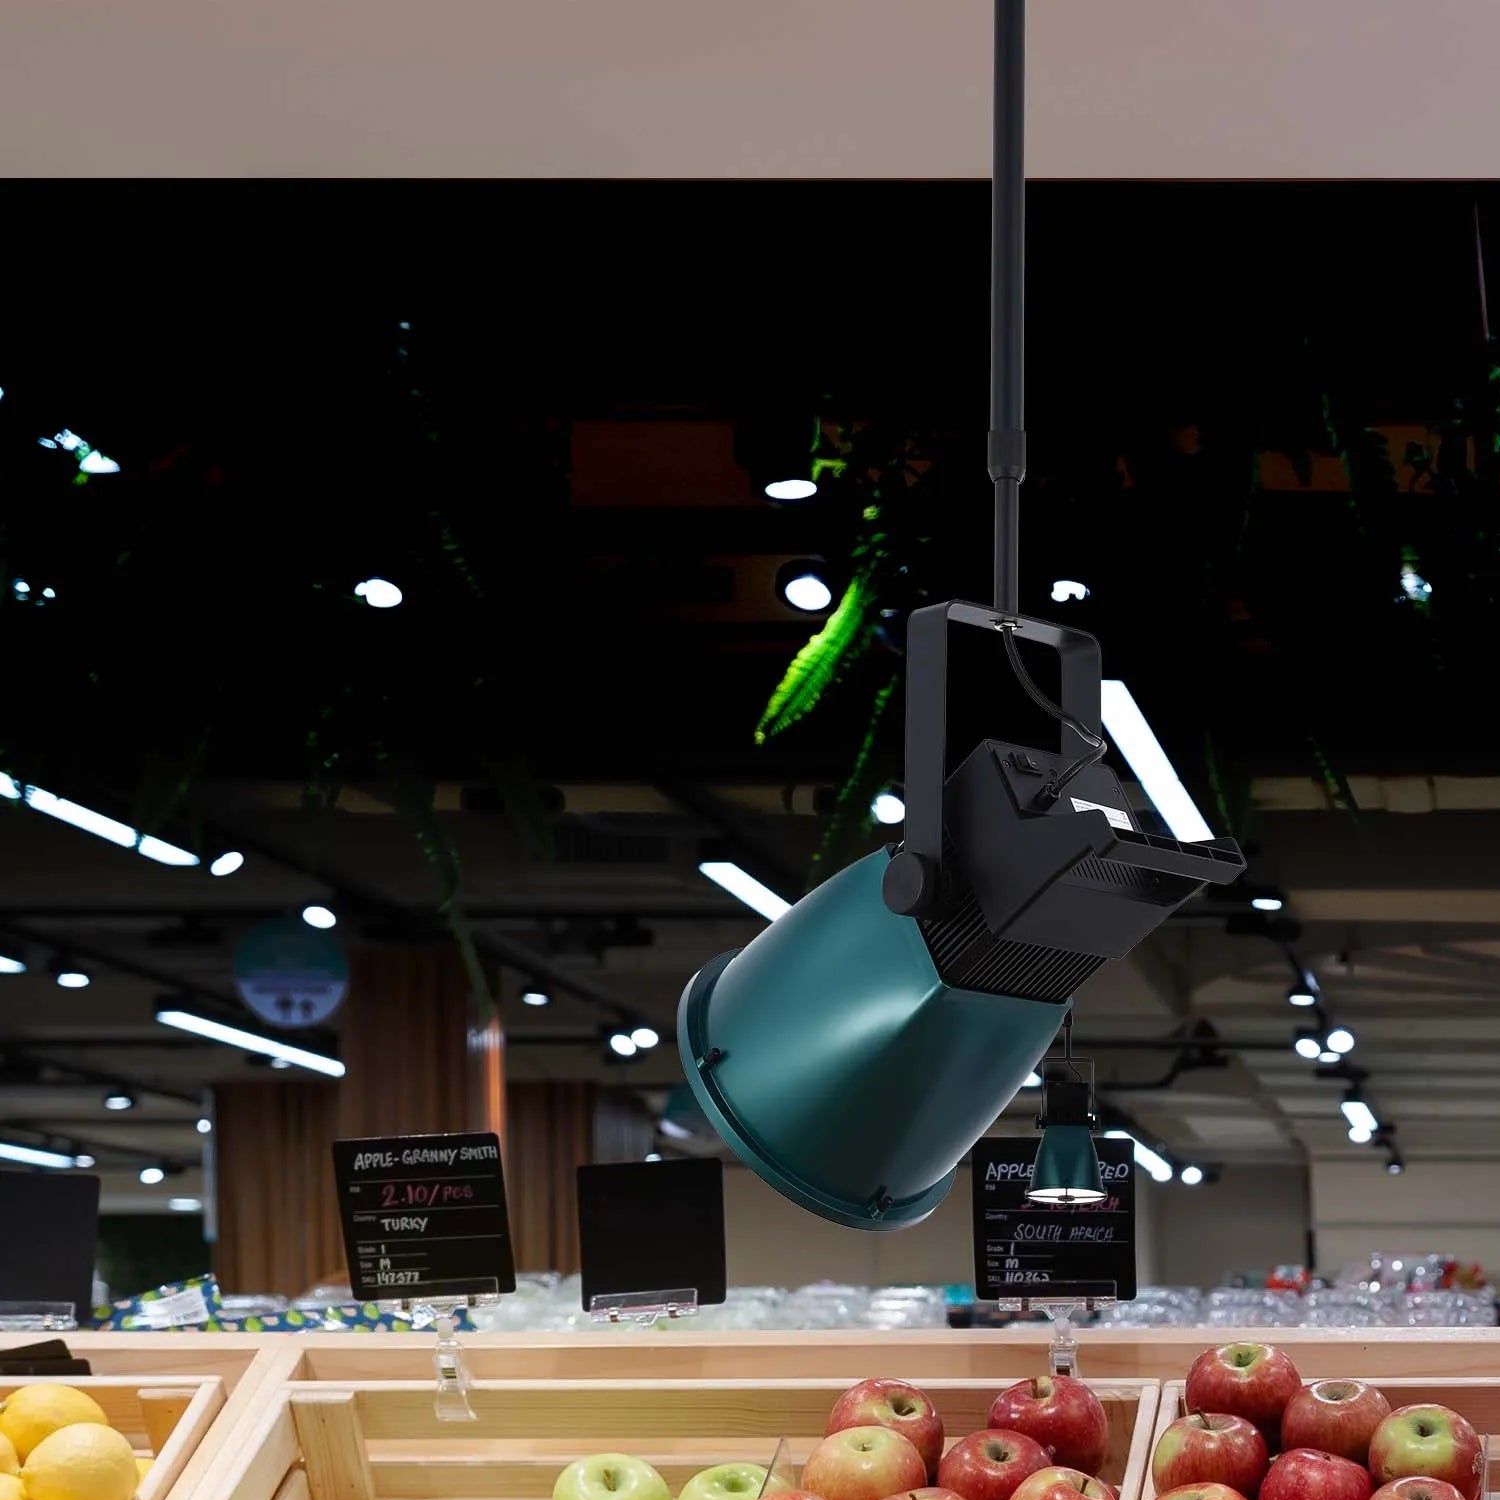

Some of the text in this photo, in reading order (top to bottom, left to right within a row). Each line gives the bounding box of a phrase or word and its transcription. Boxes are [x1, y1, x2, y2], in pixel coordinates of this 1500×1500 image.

[401, 1148, 457, 1166] GRANNY
[459, 1146, 499, 1161] SMITH
[380, 1216, 429, 1233] TURKY
[1014, 1223, 1115, 1242] SOUTH AFRICA
[379, 1258, 391, 1270] M
